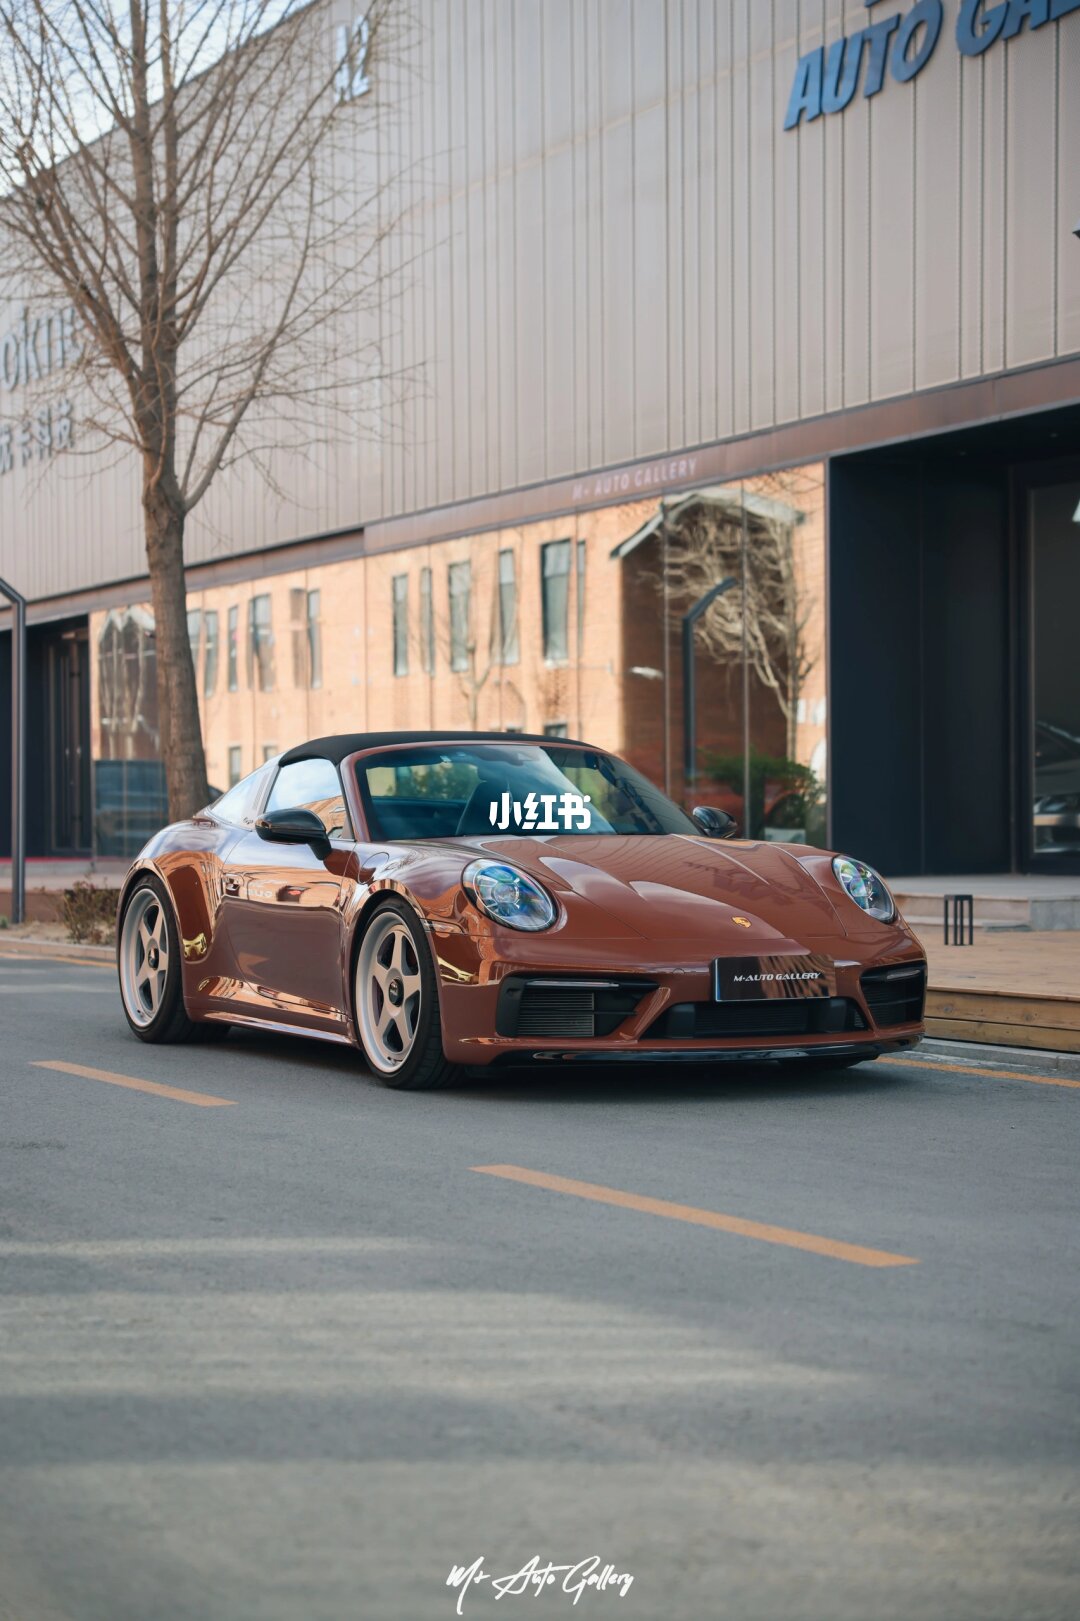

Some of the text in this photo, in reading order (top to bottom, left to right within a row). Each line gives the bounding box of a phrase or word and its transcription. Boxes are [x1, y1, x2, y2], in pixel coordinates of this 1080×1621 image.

[783, 0, 1080, 131] AUTO GA
[594, 474, 630, 497] AUTO
[775, 972, 820, 981] GALLERY
